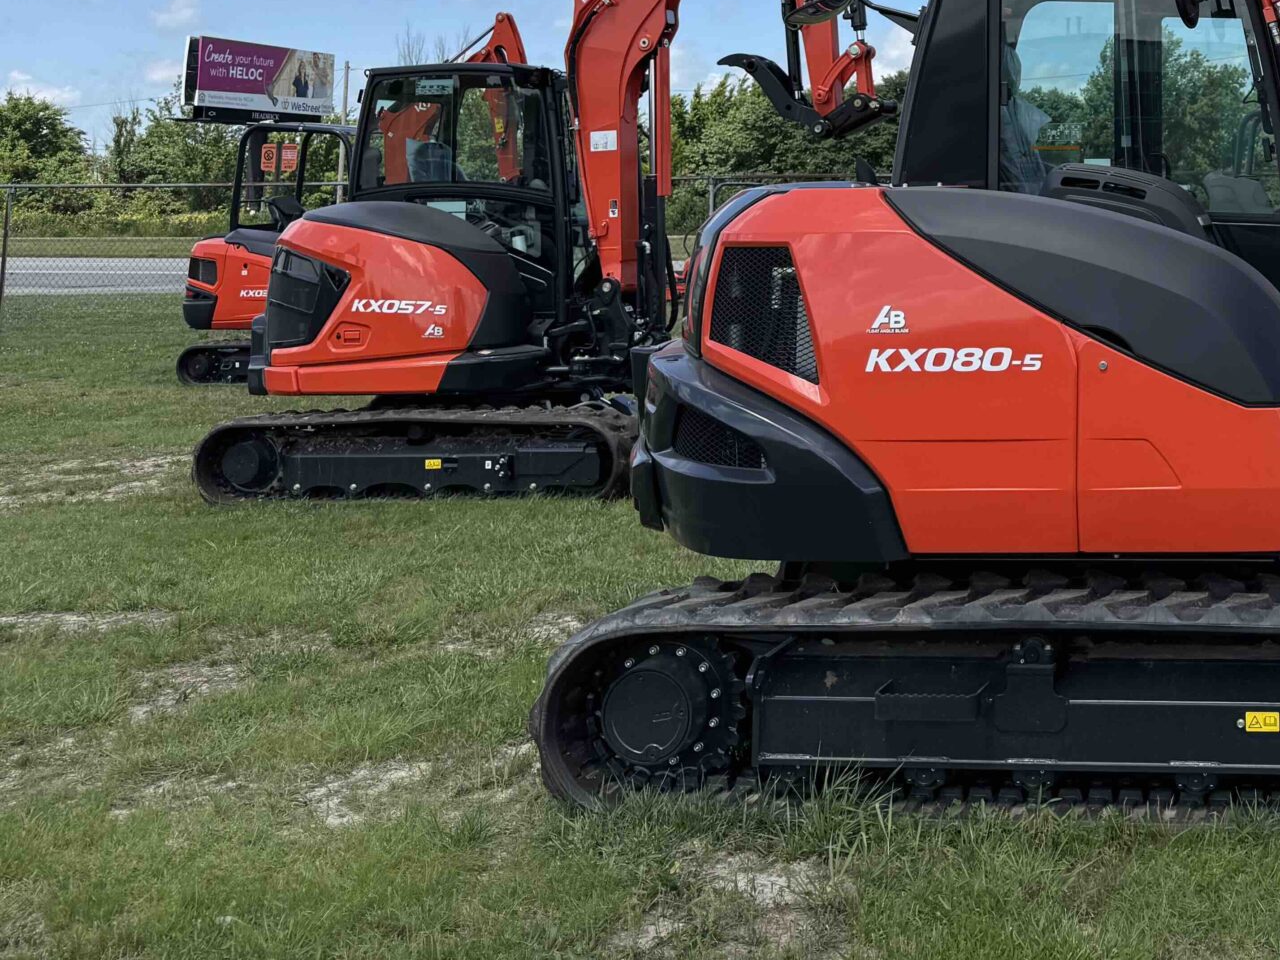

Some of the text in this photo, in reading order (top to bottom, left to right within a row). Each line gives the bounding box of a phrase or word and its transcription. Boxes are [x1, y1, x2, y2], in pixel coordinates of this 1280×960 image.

[204, 43, 274, 67] Create your future
[210, 65, 263, 81] with HELOC
[351, 298, 447, 315] KX057-5
[872, 305, 906, 329] AB
[424, 324, 444, 336] AB
[865, 347, 1043, 372] KX080-5
